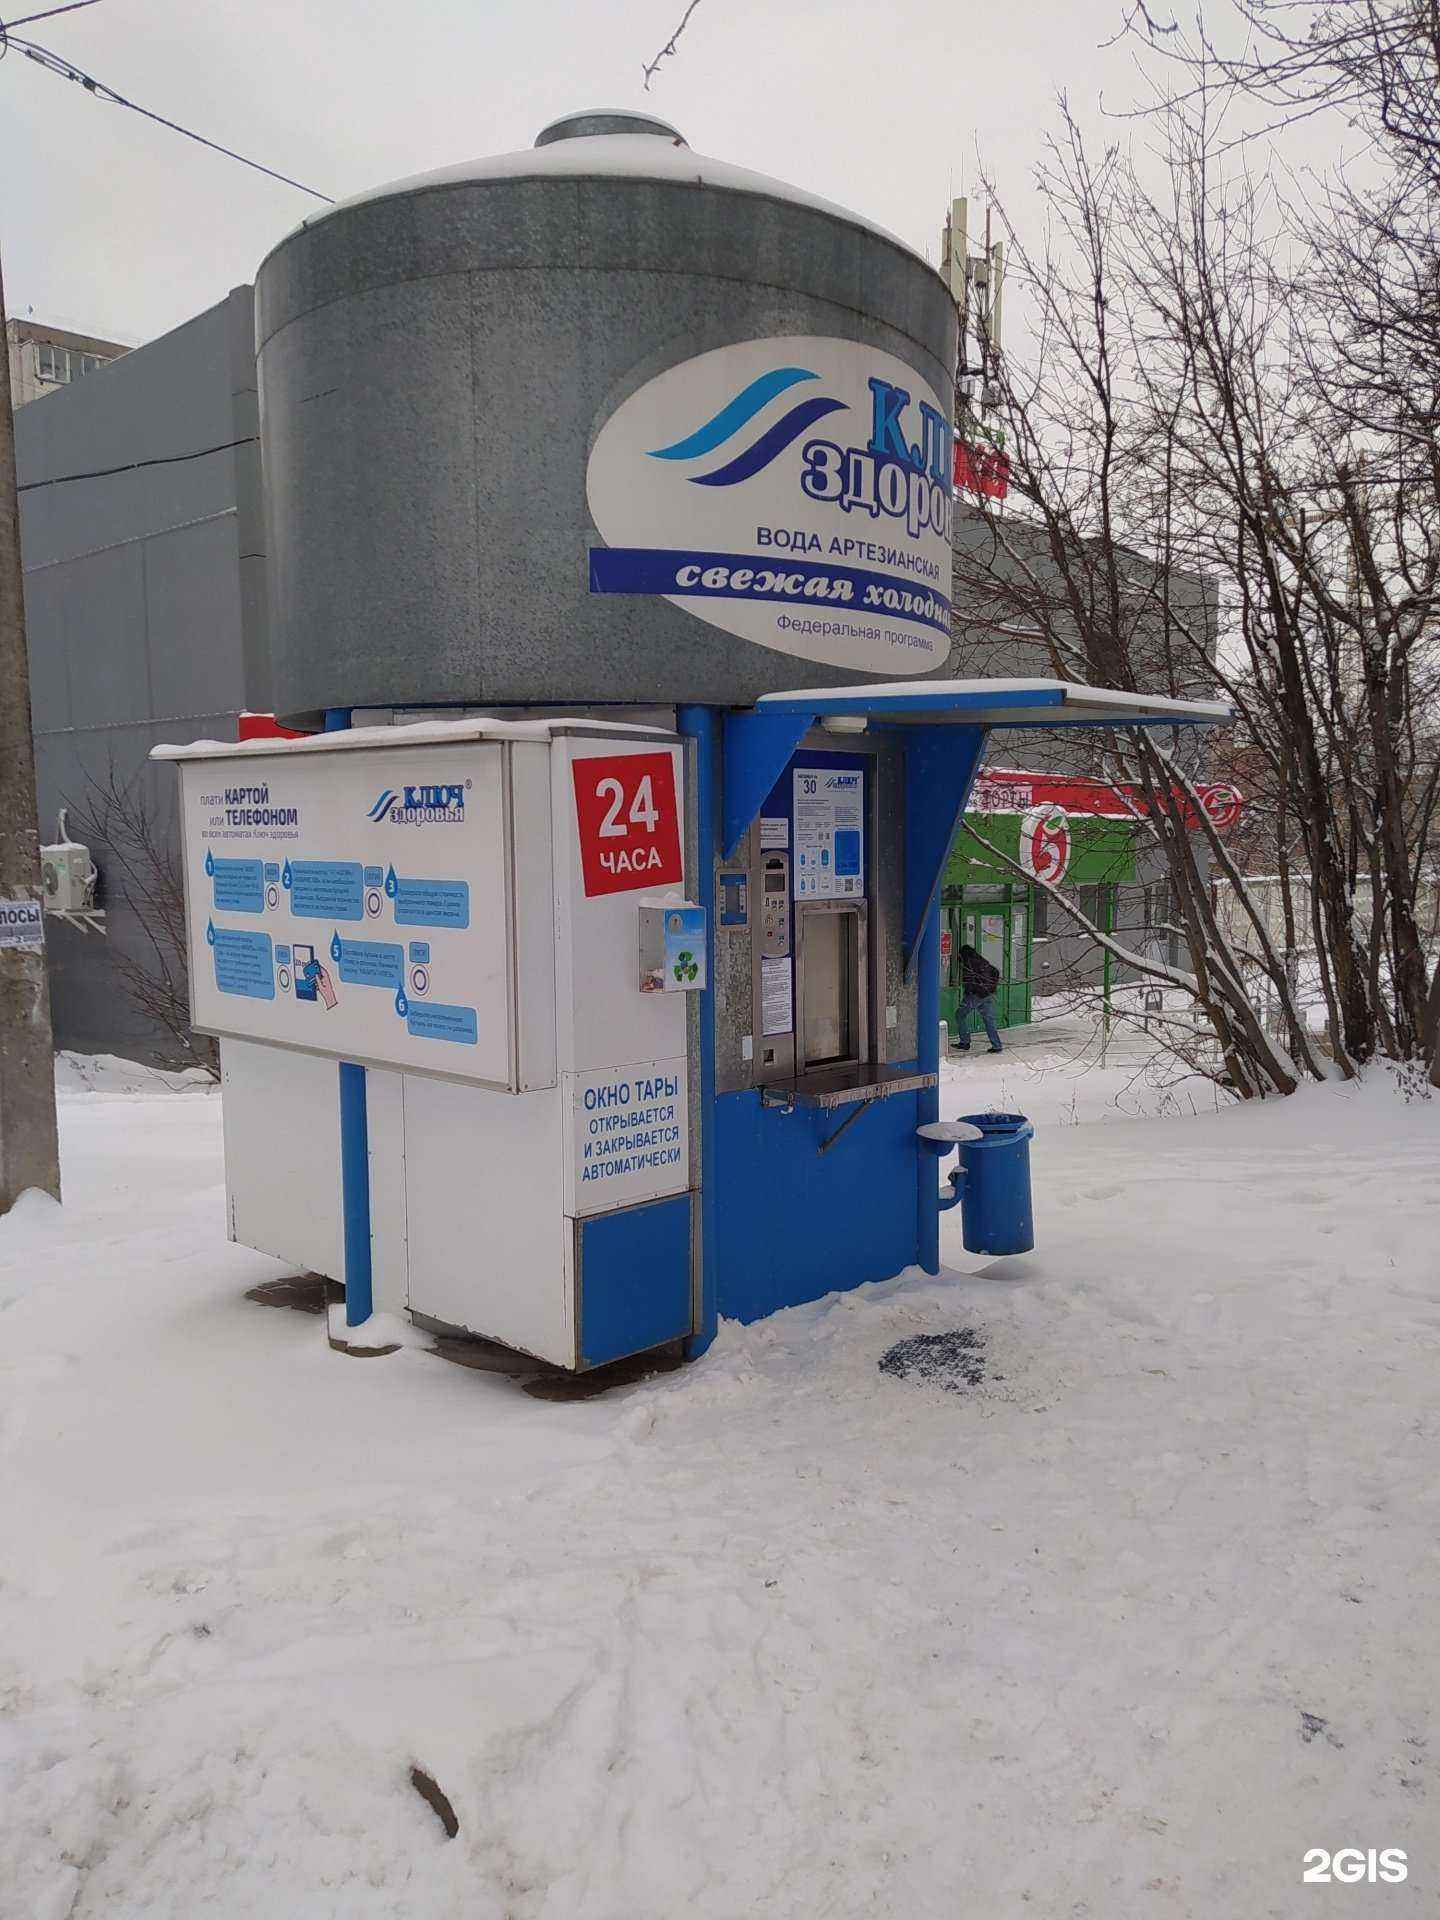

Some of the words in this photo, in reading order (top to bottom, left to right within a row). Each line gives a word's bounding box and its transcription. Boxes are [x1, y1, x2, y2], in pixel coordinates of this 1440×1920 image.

[756, 527, 822, 554] ВОДА
[828, 536, 940, 579] АРТЕЗИАНСКАЯ
[675, 564, 854, 600] свежая
[863, 584, 951, 630] холодна
[777, 614, 881, 641] Федеральная
[225, 782, 269, 805] КАРТОЙ
[404, 785, 464, 807] КЛЮЧ
[803, 780, 817, 794] 30
[209, 815, 224, 826] или
[225, 808, 298, 826] ТЕЛЕФОНОМ
[594, 774, 660, 839] 24
[599, 846, 662, 874] ЧАСА
[284, 873, 290, 884] 2
[389, 879, 395, 893] 3
[333, 945, 339, 957] 5
[584, 1083, 630, 1110] ОКНО
[635, 1076, 678, 1101] ТАРЫ
[590, 1105, 674, 1134] ОТКРЫВАЕТСЯ
[584, 1143, 592, 1158] И
[596, 1126, 679, 1156] ЗАКРЫВАЕТСЯ
[582, 1147, 681, 1181] АВТОМАТИЧЕСКИ
